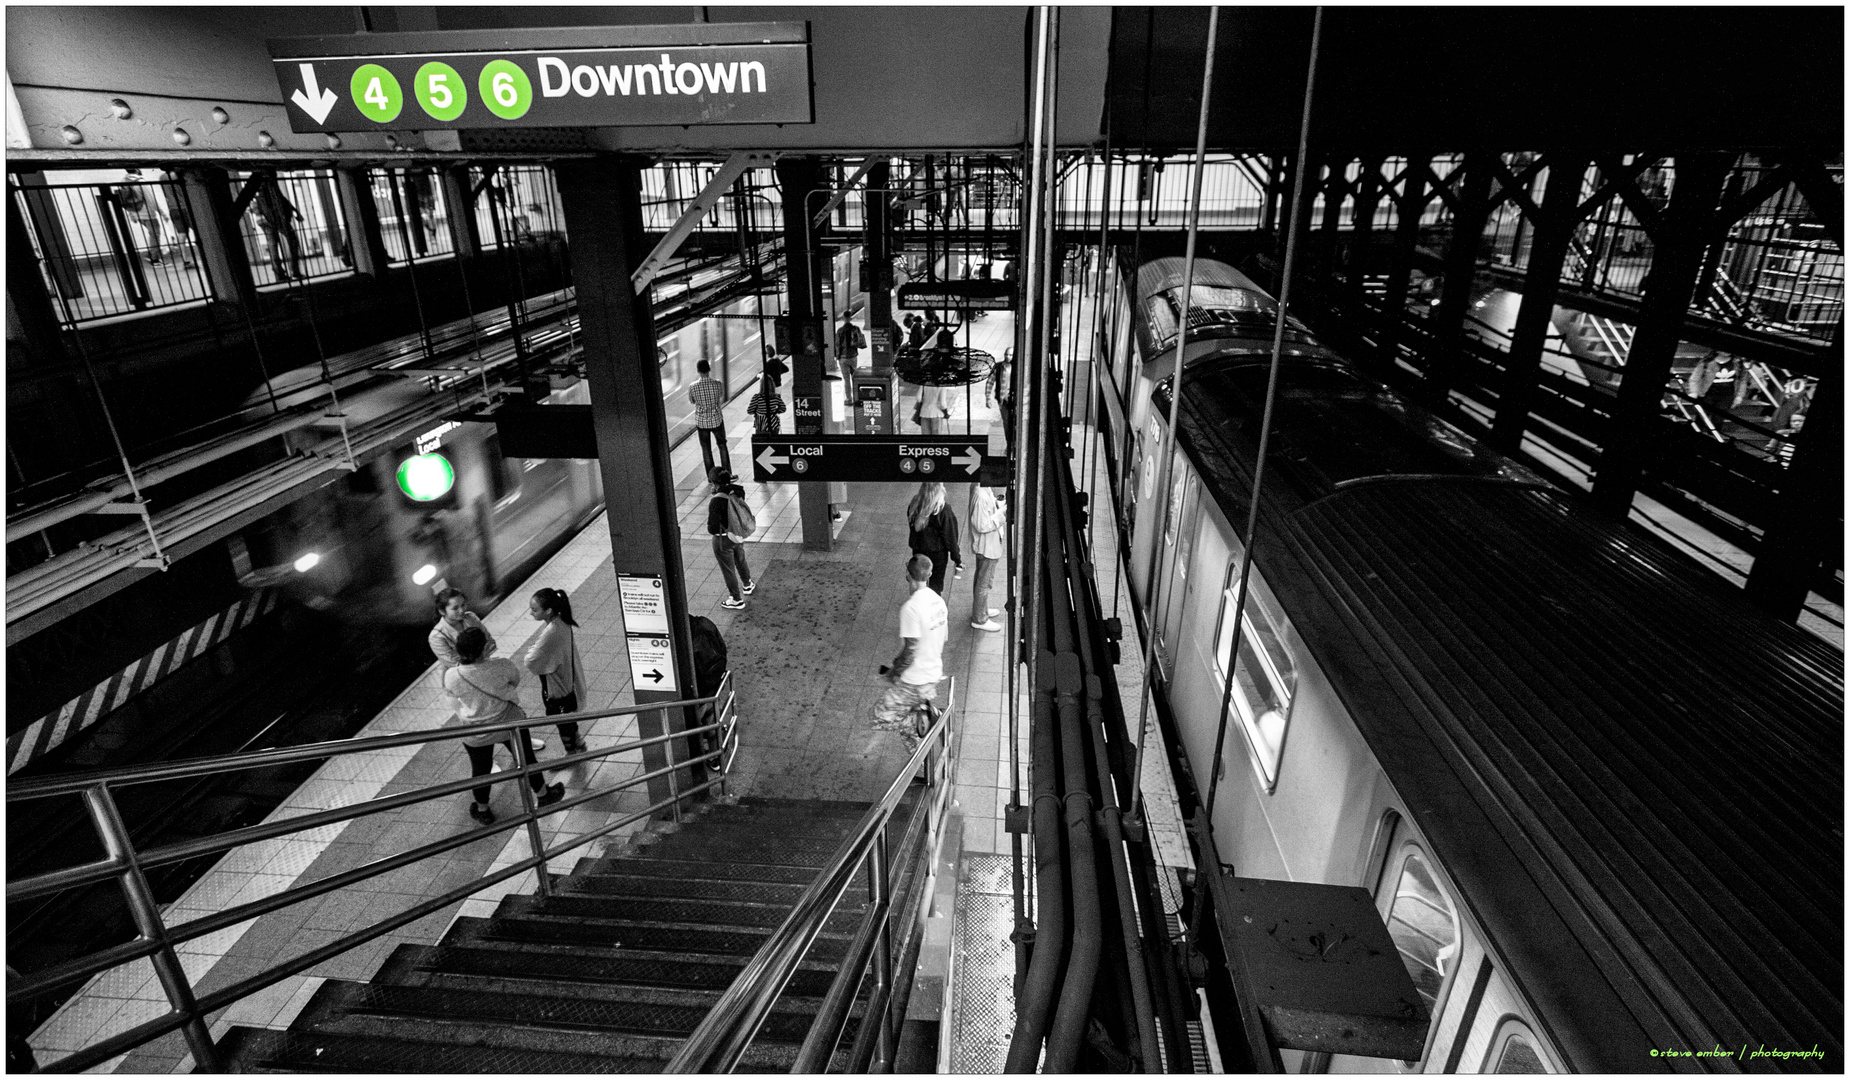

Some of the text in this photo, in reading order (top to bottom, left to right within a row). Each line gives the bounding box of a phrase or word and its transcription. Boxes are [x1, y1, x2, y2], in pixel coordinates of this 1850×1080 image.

[364, 53, 767, 110] 4 5 6 Downtown
[795, 398, 809, 409] 14
[795, 409, 821, 417] Street
[790, 444, 823, 456] Local
[899, 445, 950, 458] Express
[796, 460, 805, 471] 6
[903, 461, 931, 471] 4 5
